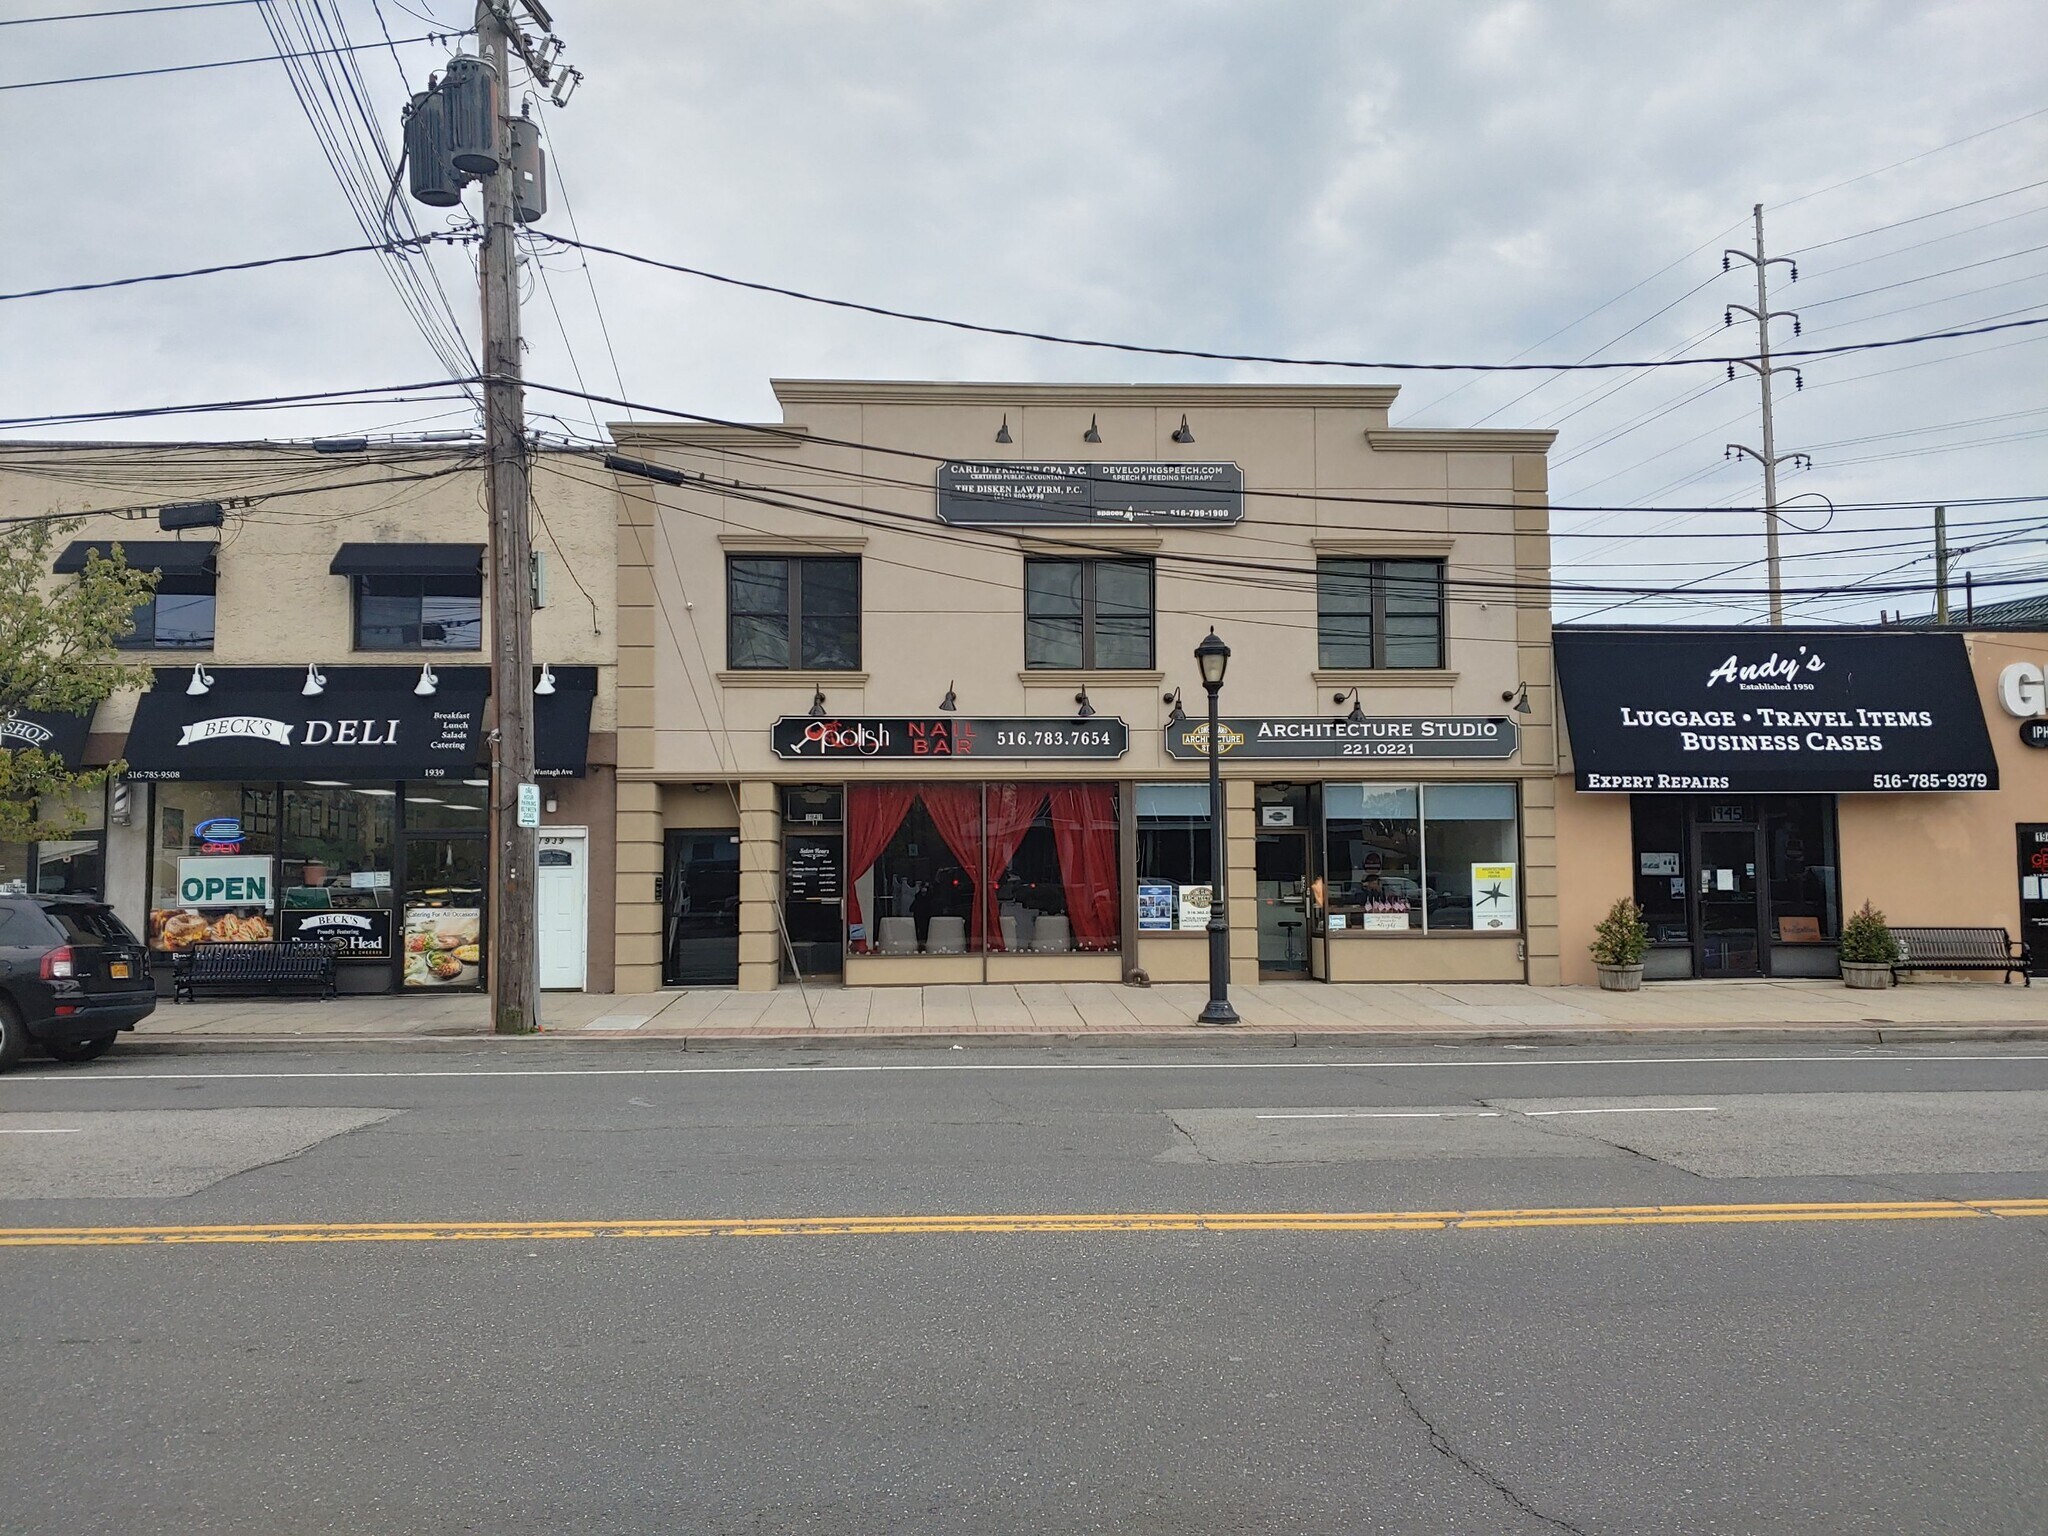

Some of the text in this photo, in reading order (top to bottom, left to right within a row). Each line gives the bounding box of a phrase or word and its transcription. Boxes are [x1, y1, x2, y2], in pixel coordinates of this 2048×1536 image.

[951, 465, 979, 474] CARL
[1069, 466, 1087, 475] P.C.
[1103, 466, 1223, 475] DEVELOPINGSPEECH.COM
[955, 484, 1082, 494] THE DISKEN LAW FIRM, P.C.
[1170, 509, 1229, 517] 516-799-1900
[1707, 646, 1825, 687] Andy's
[1739, 682, 1814, 691] Established 1950
[1998, 662, 2048, 717] G
[433, 711, 470, 719] Breakfast
[1620, 707, 1933, 727] LUGGAGE TRAVEL ITEMS
[204, 718, 272, 736] BECK'S
[443, 721, 468, 729] Lunch
[908, 721, 977, 737] NAIL
[1257, 721, 1498, 737] ARCHITECTURE STUDIO
[4, 721, 50, 743] SHOP
[301, 719, 400, 745] DELI
[441, 731, 467, 739] Salads
[997, 731, 1111, 746] 516.783.7654
[1185, 735, 1241, 743] ARCHICTURE
[1681, 731, 1883, 751] BUSINESS CASES
[430, 741, 465, 750] Catering
[913, 738, 973, 754] BAR
[1201, 744, 1225, 752] STIO
[1343, 743, 1415, 755] 221.0221
[127, 771, 180, 779] 516-785-9508
[424, 768, 445, 777] 1939
[534, 768, 573, 776] Wantagh Ave
[1588, 773, 1729, 788] EXPERT REPAIRS
[1873, 773, 1988, 788] 516-785-9379
[1713, 806, 1742, 821] 1945
[201, 843, 241, 853] OPEN
[181, 877, 266, 901] OPEN
[318, 915, 359, 924] BECK'S
[408, 911, 430, 919] Catering
[350, 936, 382, 949] Head
